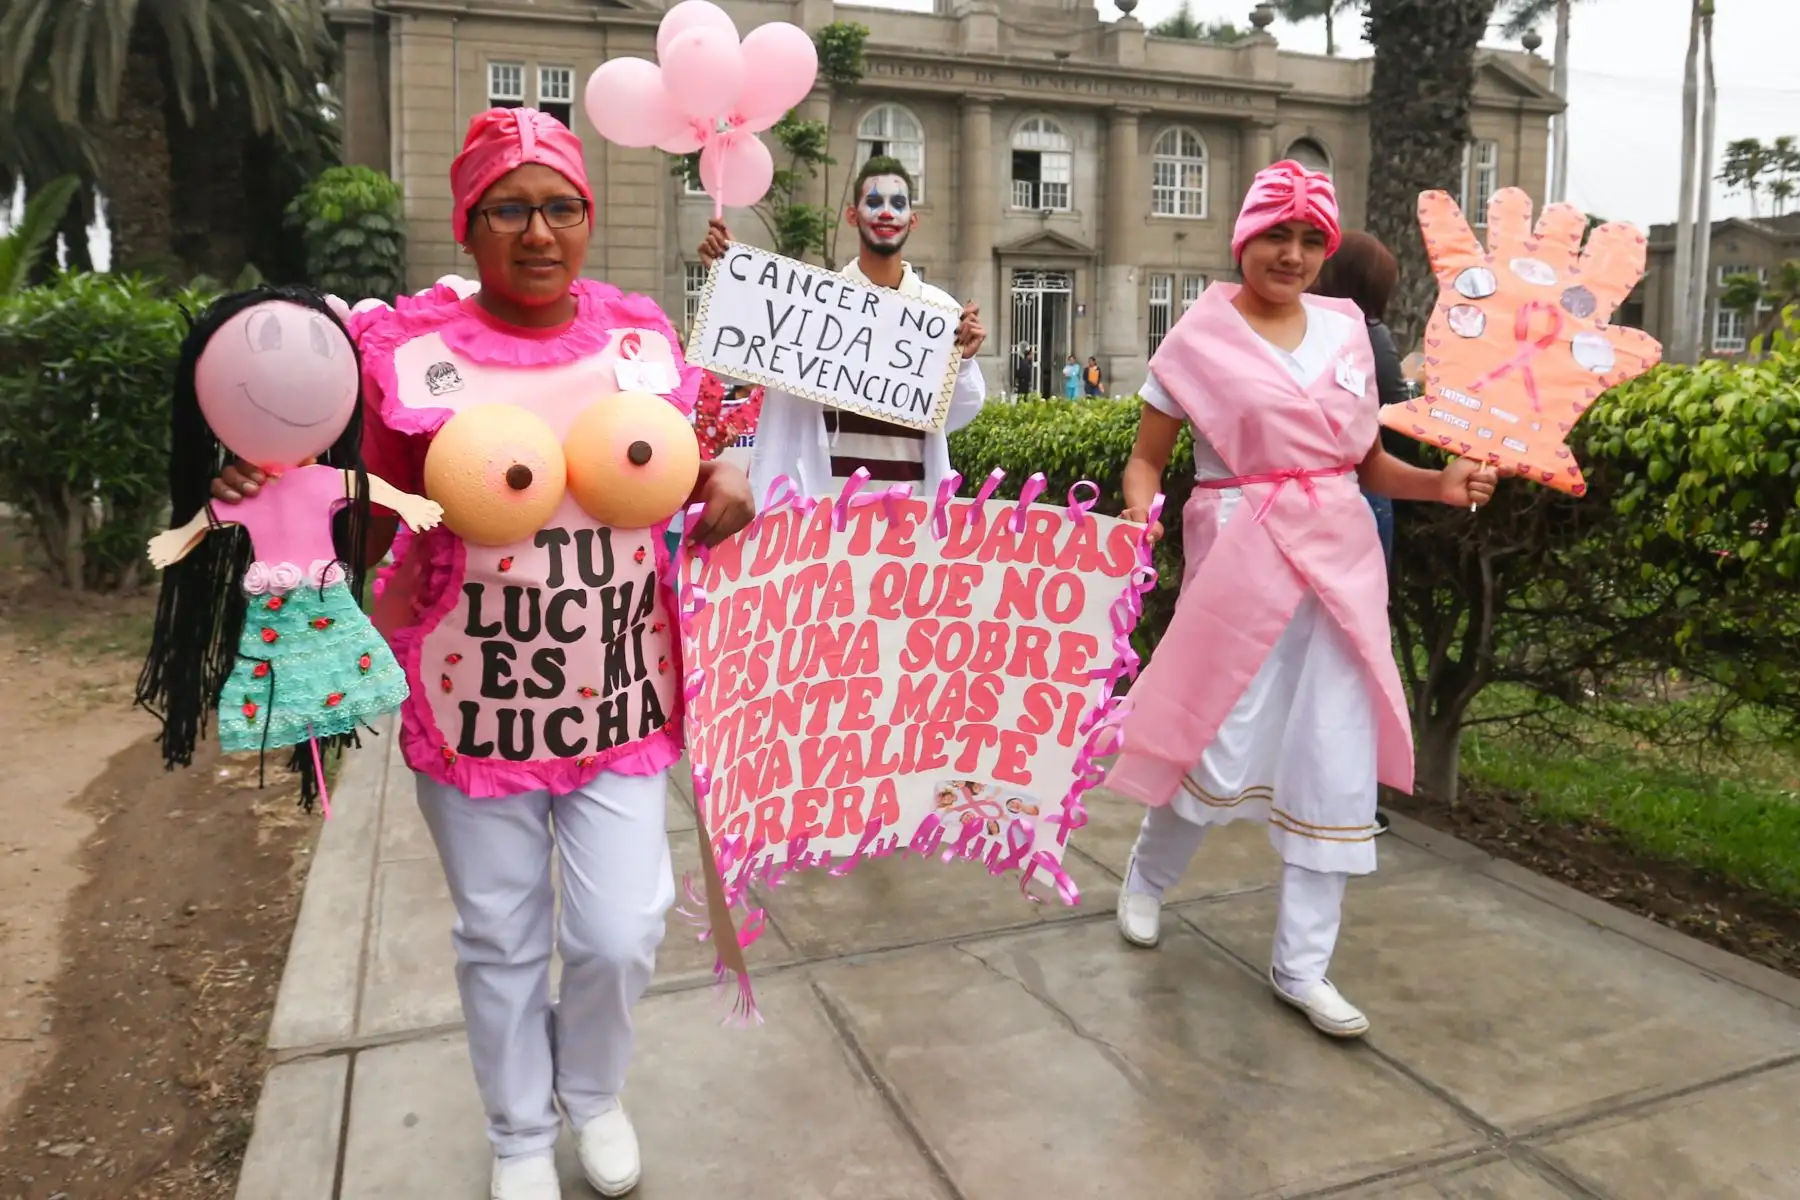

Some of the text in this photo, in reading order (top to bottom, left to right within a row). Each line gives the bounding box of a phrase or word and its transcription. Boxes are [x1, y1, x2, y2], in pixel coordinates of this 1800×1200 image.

[766, 299, 934, 378] VIDA SI
[899, 307, 946, 339] NO
[712, 325, 934, 416] PREVENCION
[533, 526, 615, 589] TU
[748, 497, 833, 578] DIA
[846, 497, 928, 559] TE
[940, 503, 1148, 578] DARAS
[462, 571, 656, 644] LUCHA
[867, 561, 984, 620] QUE
[994, 566, 1086, 625] NO
[480, 622, 648, 700] ES MI
[777, 619, 880, 686] UNA
[898, 618, 1100, 688] SOBRE
[456, 679, 666, 761] LUCHA
[889, 670, 1005, 727] MAS
[1017, 682, 1087, 748] SI
[710, 720, 1038, 834] UNA VALIETE
